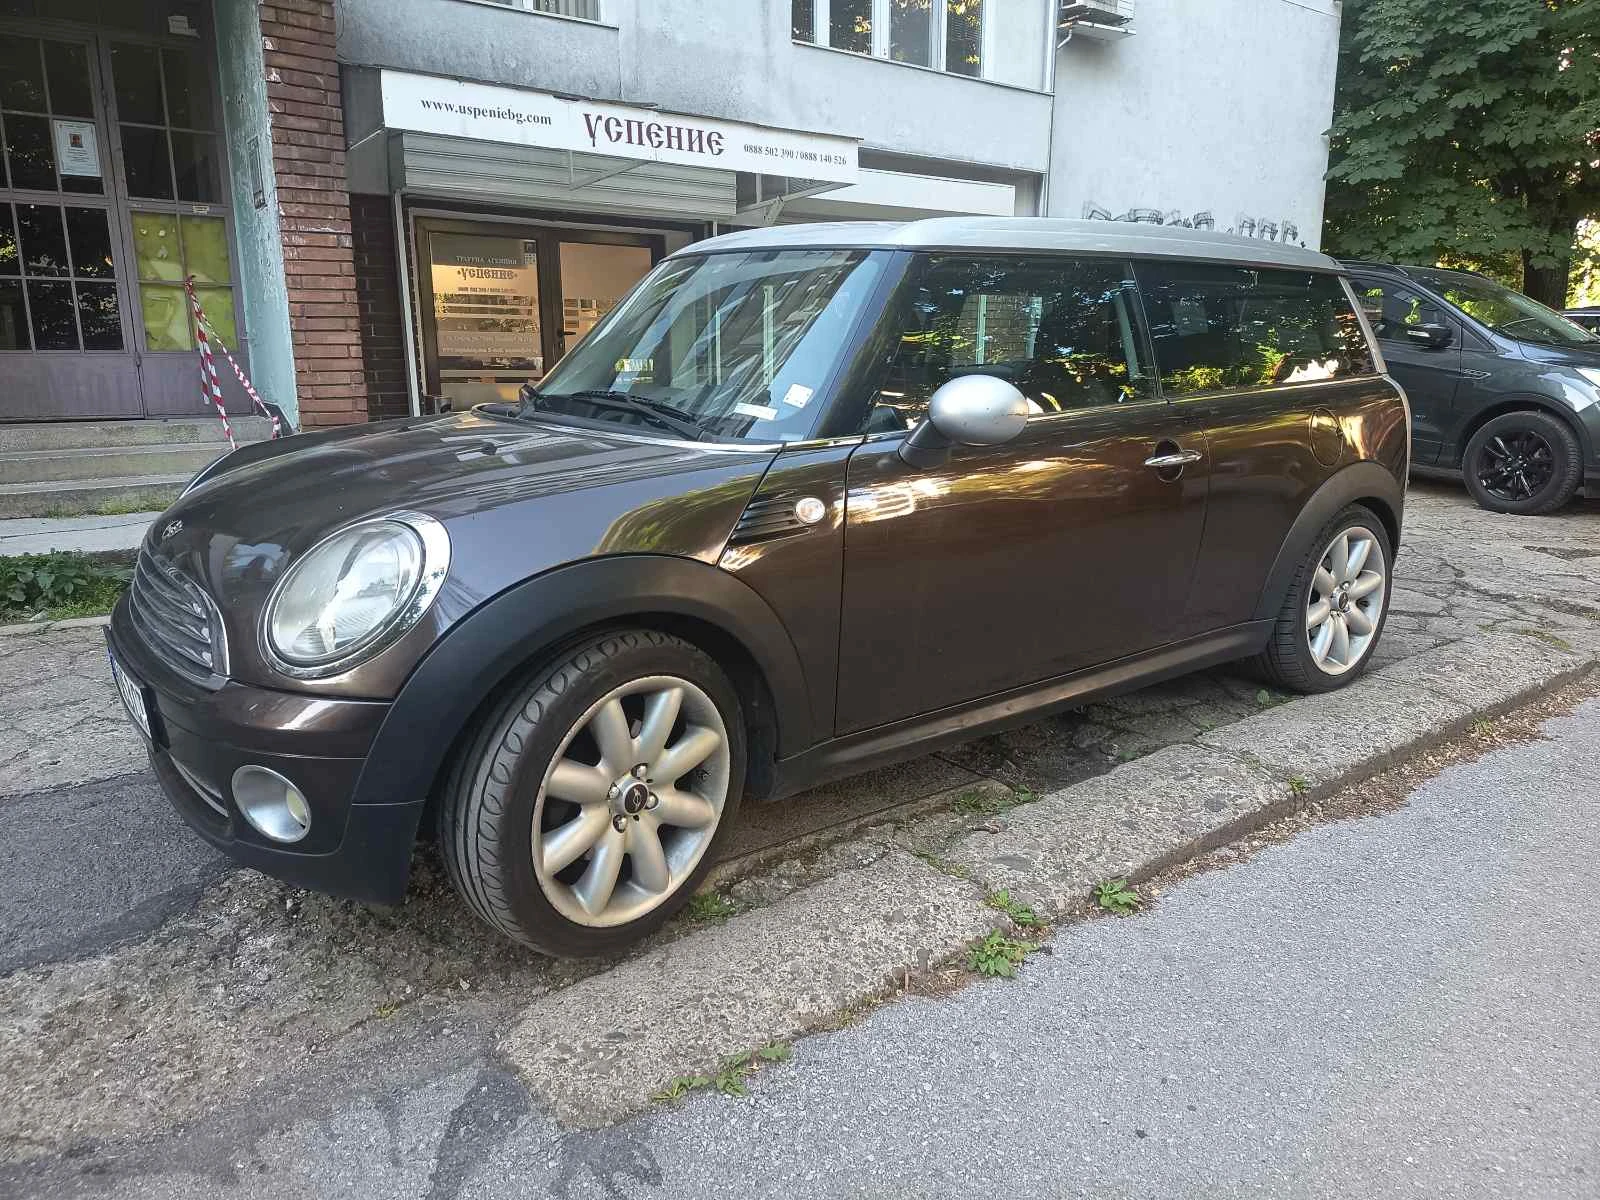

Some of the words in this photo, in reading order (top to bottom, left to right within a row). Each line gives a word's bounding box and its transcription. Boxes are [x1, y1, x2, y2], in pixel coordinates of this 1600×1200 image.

[420, 99, 552, 125] www.uspeniebg.com
[583, 112, 725, 156] УСПЕНИЕ
[743, 143, 763, 155] 0888
[764, 146, 779, 157] 502
[780, 148, 794, 160] 390
[799, 151, 818, 161] 0888
[819, 153, 832, 164] 140
[834, 155, 847, 166] 526
